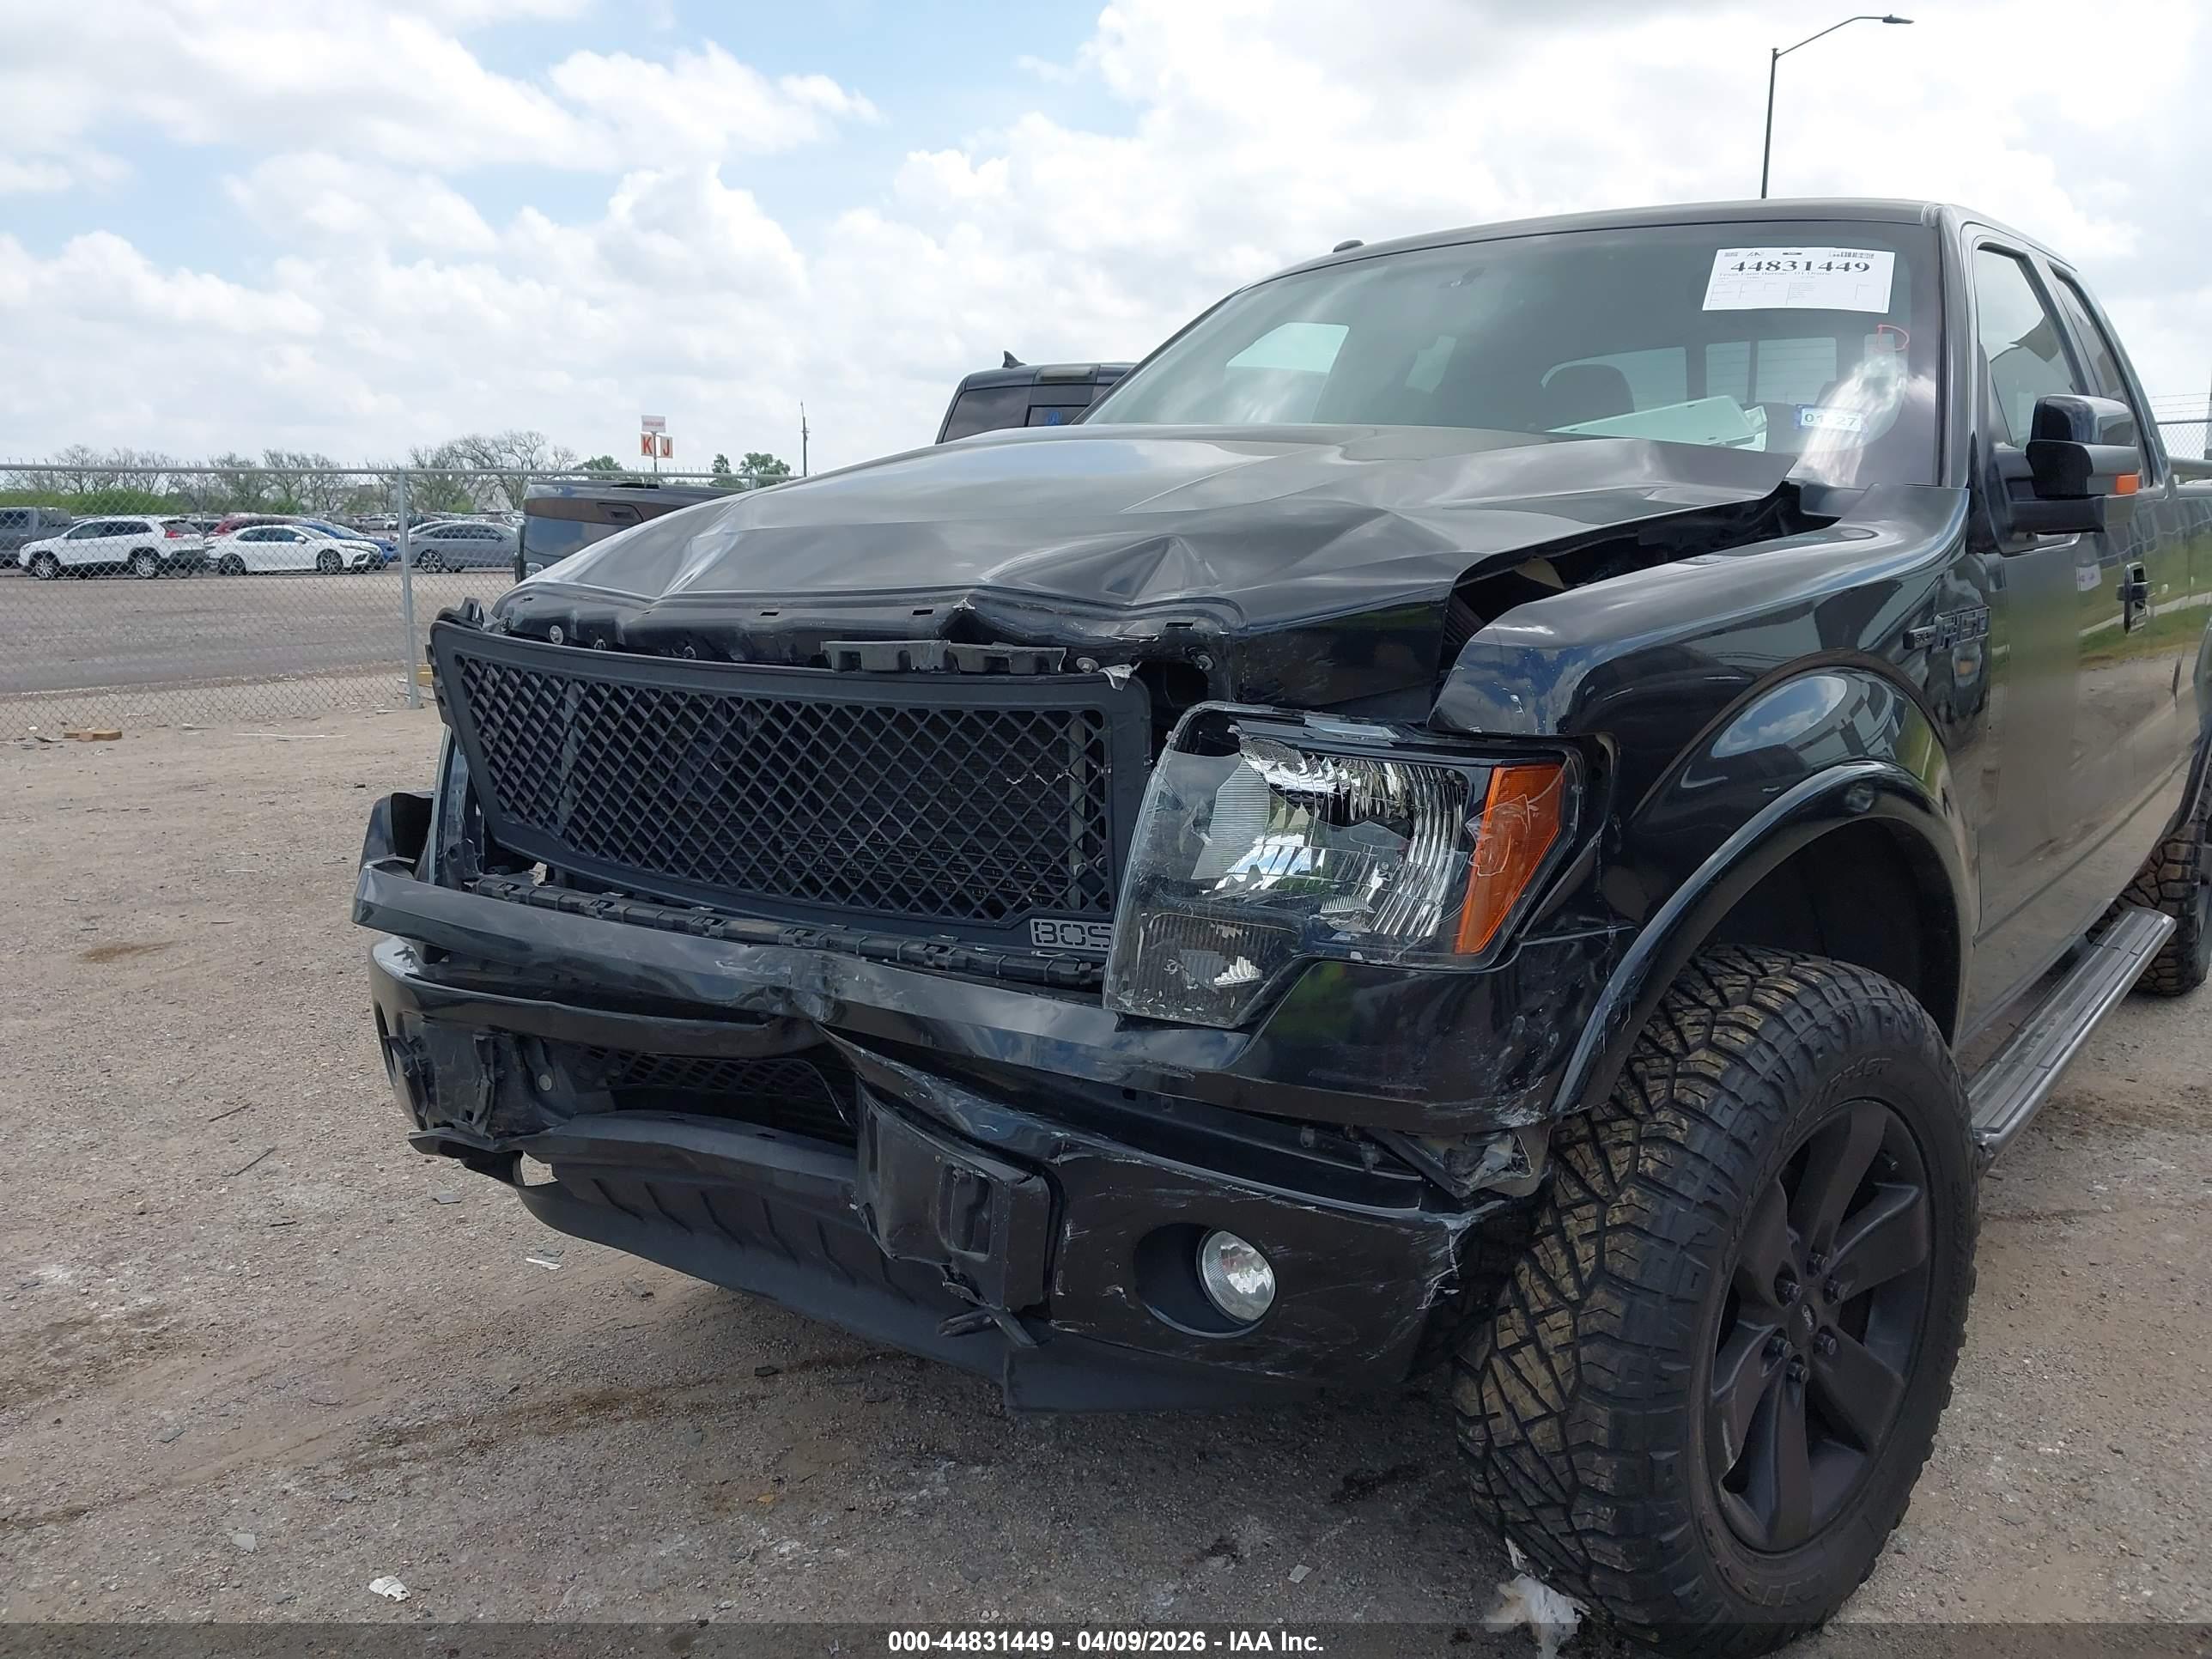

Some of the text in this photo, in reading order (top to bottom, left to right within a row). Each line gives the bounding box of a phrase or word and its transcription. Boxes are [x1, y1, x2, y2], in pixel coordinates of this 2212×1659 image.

[1730, 259, 1871, 273] 44831449
[642, 436, 670, 456] K J
